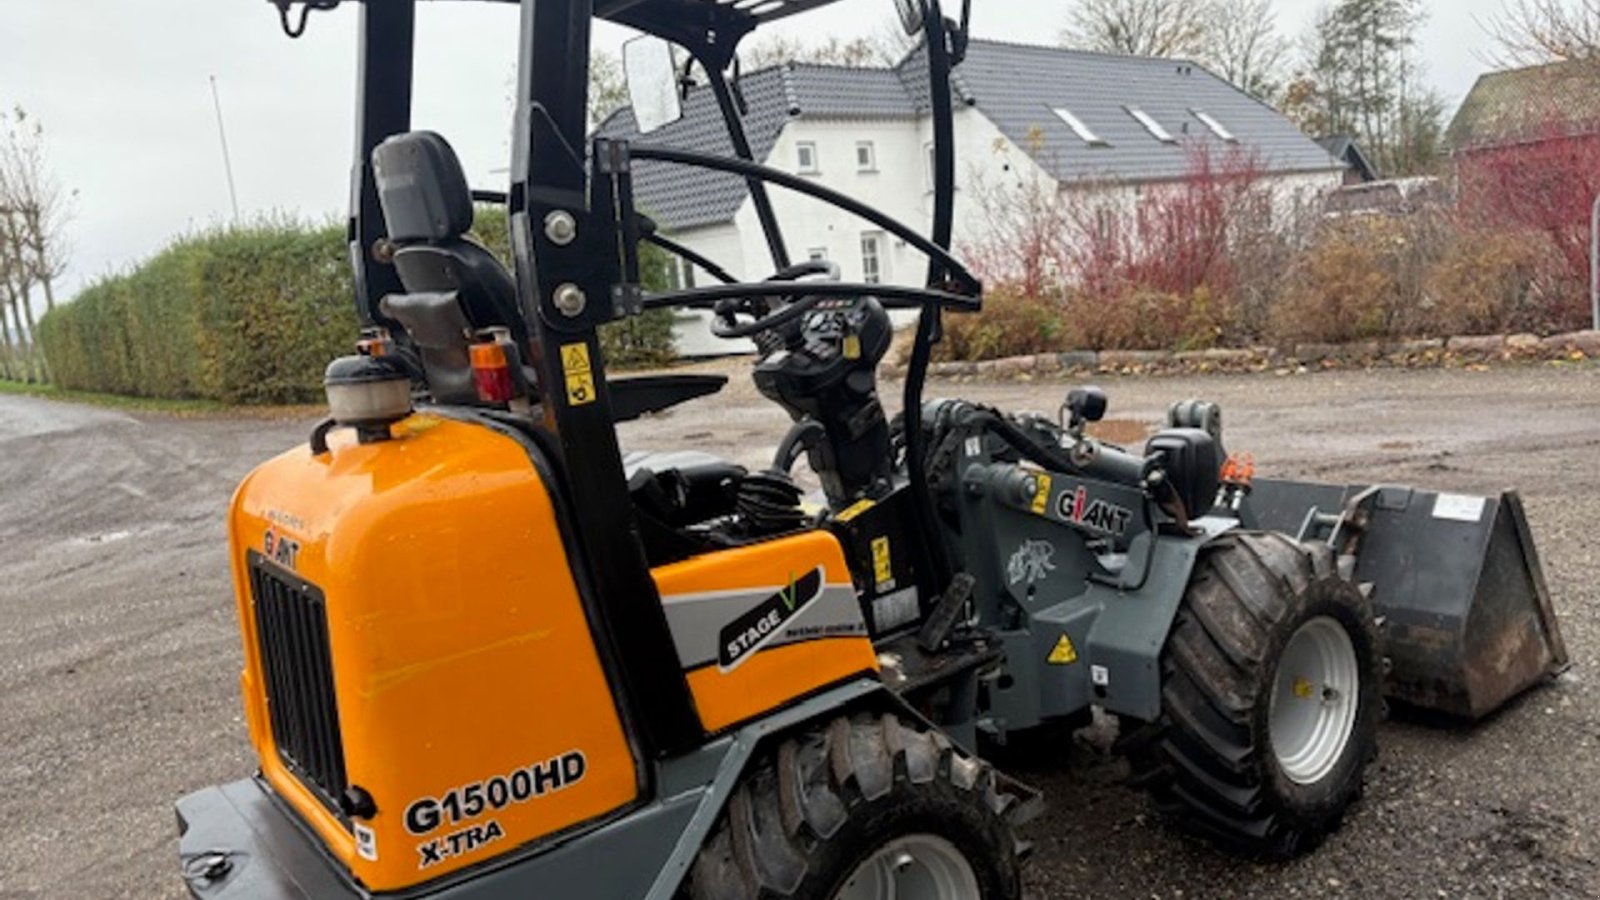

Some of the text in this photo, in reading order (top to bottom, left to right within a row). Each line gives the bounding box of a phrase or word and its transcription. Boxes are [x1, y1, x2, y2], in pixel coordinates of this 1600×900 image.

[727, 609, 781, 658] STAGE
[405, 750, 586, 834] G1500HD
[418, 820, 505, 868] X-TRA
